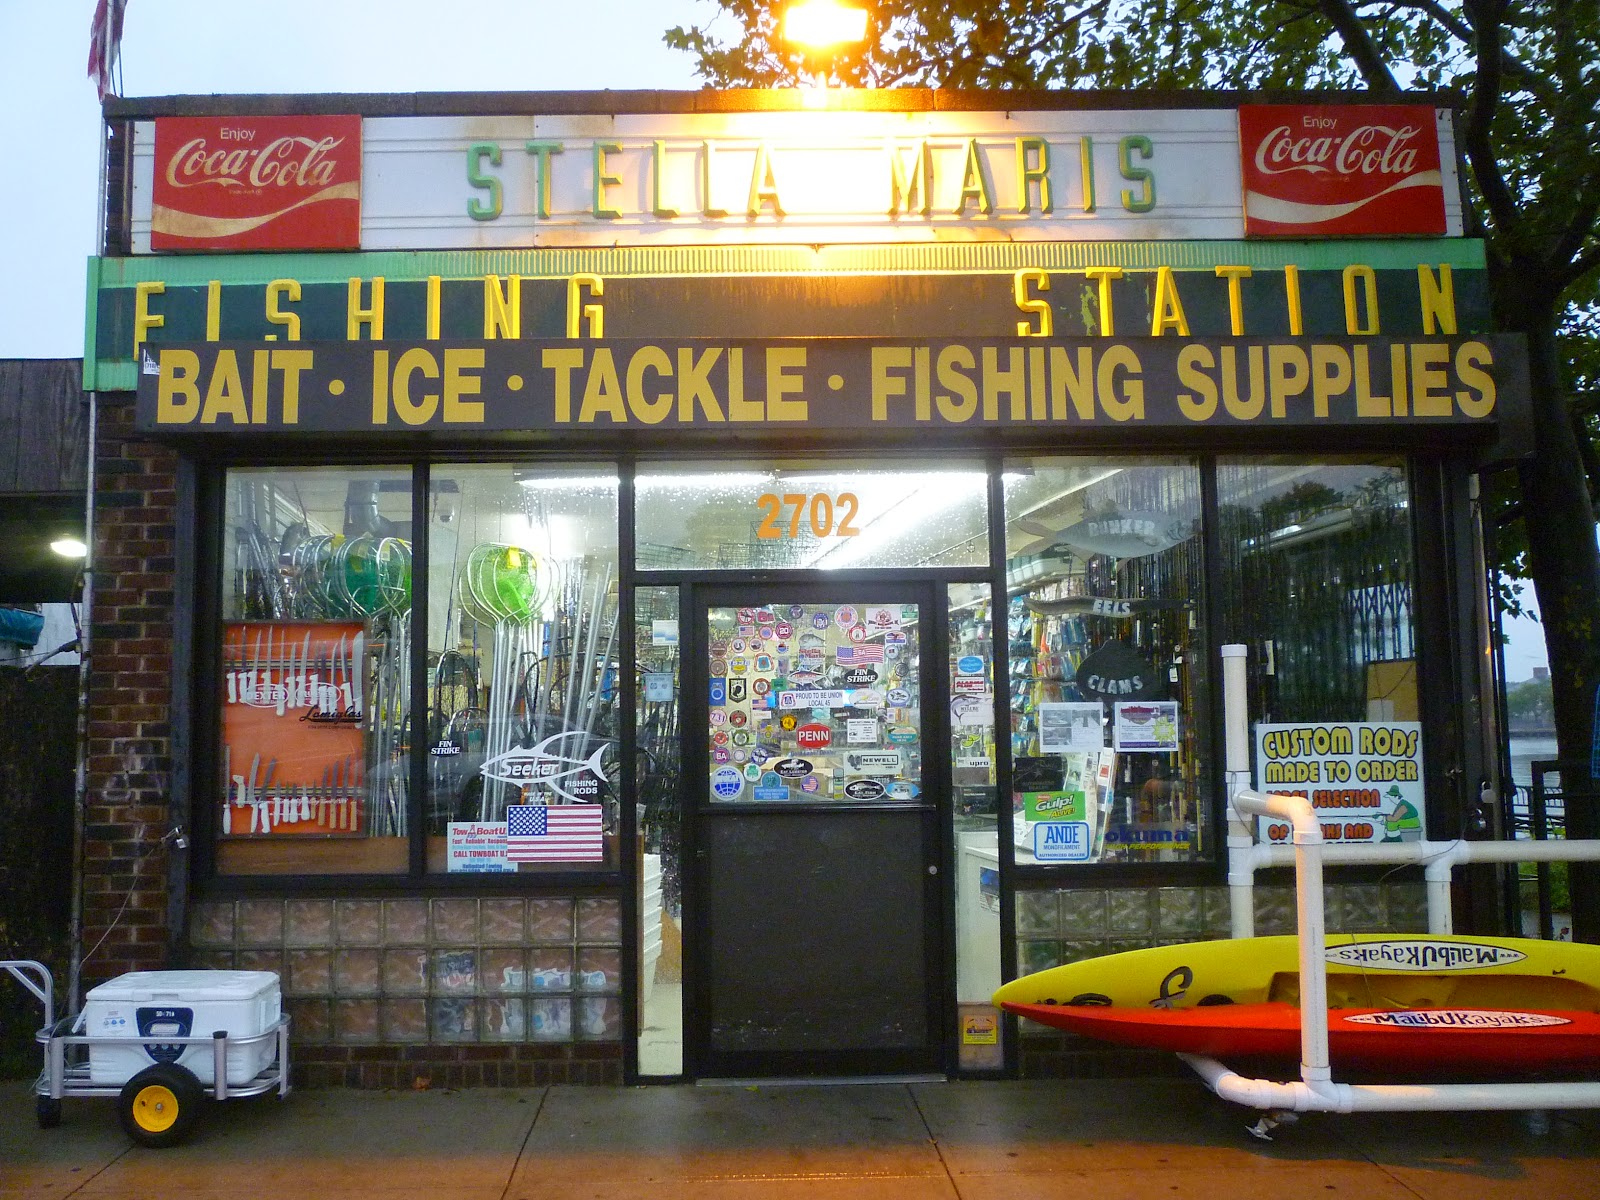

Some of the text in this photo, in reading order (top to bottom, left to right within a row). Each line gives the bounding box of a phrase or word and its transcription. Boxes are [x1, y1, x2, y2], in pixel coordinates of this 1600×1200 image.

[1303, 115, 1338, 130] Enjoy
[220, 127, 256, 142] Enjoy
[1255, 125, 1423, 175] Coca-Cola
[165, 136, 346, 188] Coca-Cola
[467, 134, 1158, 221] STELLA MARIS
[134, 264, 1458, 361] FISHING STATION
[157, 341, 1497, 426] BAIT ICE TACKLE FISHING SUPPLIES
[756, 492, 860, 539] 2702
[1092, 599, 1132, 615] EELS
[1087, 674, 1143, 695] CLAMS
[827, 691, 843, 699] UNION
[798, 730, 829, 742] PENN
[1262, 726, 1418, 760] CUSTOM RODS
[430, 746, 460, 755] STRIKE
[498, 757, 560, 777] Seeker
[1265, 760, 1419, 784] MADE TO ORDER
[564, 779, 598, 787] FISHING
[573, 787, 598, 795] RODS
[1035, 794, 1075, 813] Gulp!
[1312, 788, 1381, 809] SELECTION
[1044, 825, 1080, 843] ANDE
[1104, 825, 1189, 843] okuma
[1268, 823, 1290, 840] OF
[1343, 823, 1374, 839] AND
[453, 850, 468, 858] CALL
[1128, 842, 1191, 850] PERFORMANCE
